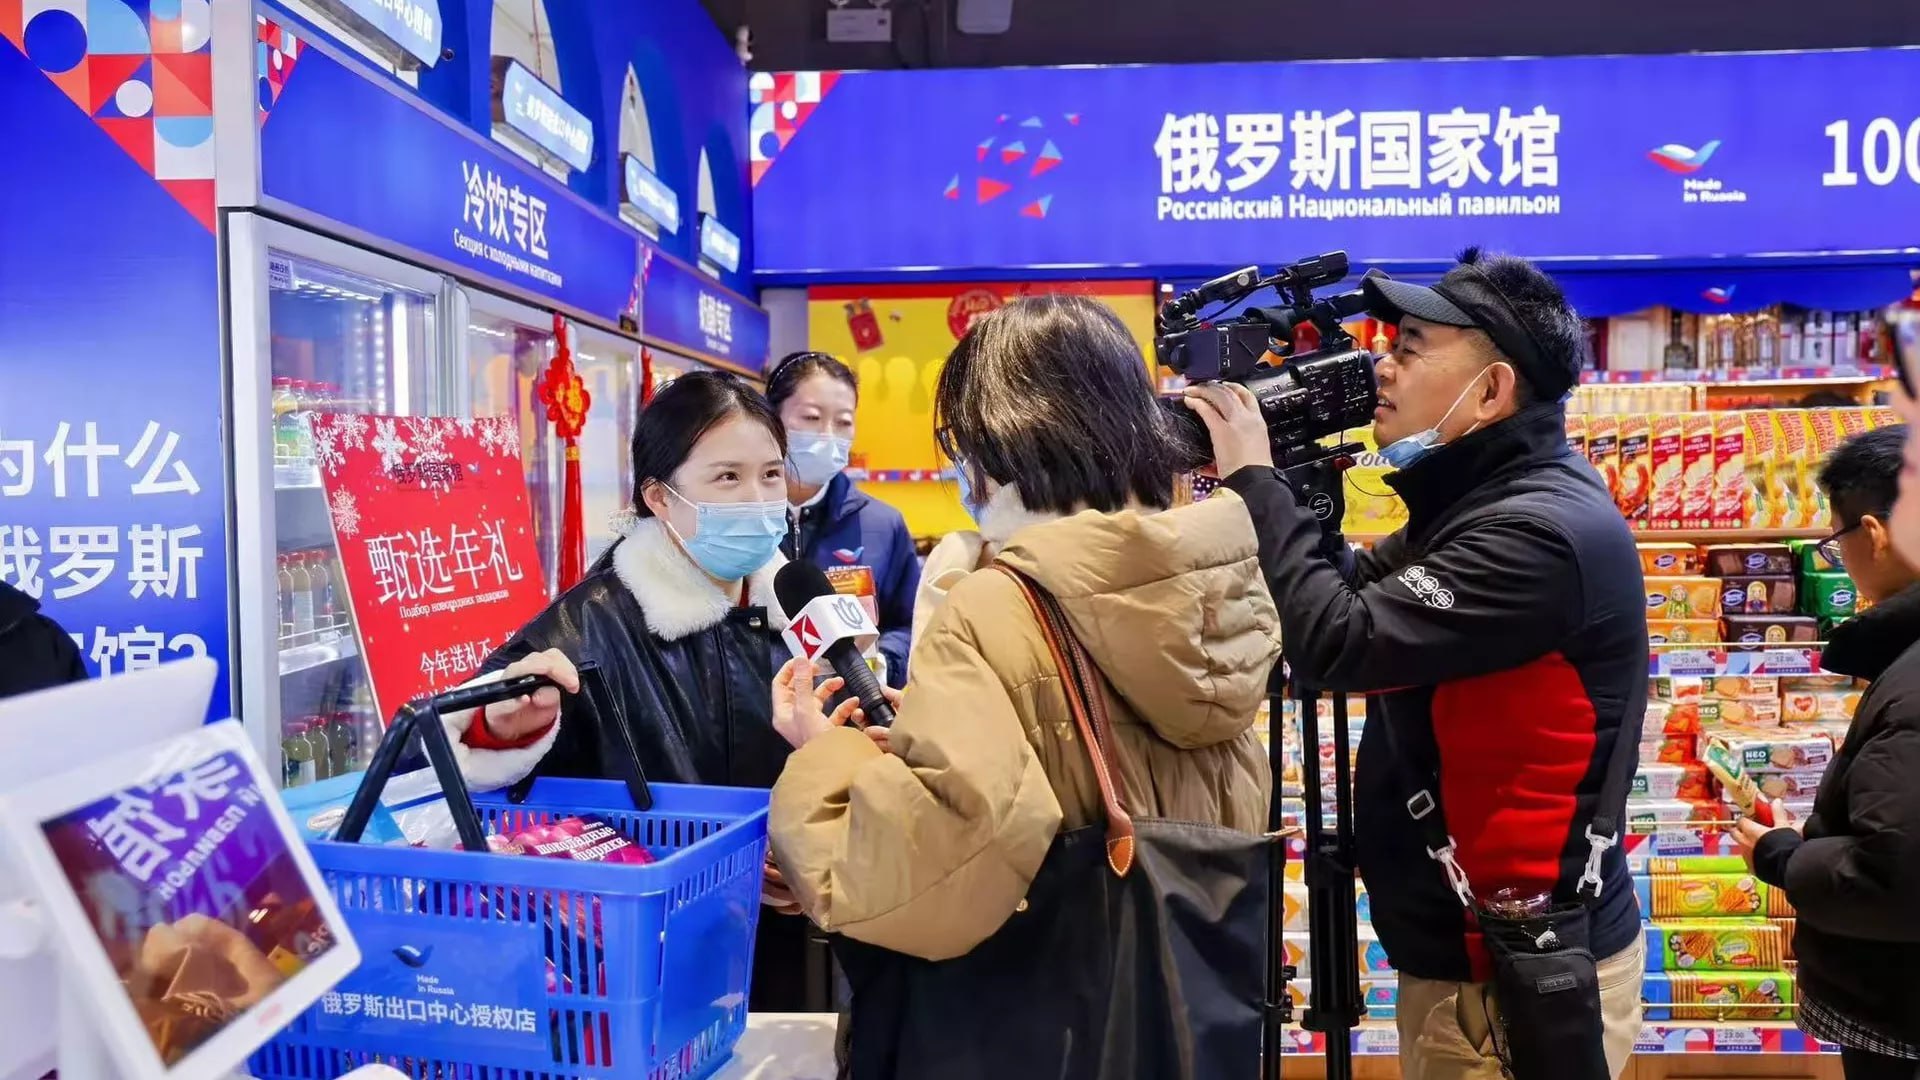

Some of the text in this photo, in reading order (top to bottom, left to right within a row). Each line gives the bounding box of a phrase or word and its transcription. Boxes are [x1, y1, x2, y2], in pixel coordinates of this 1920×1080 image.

[1154, 105, 1561, 193] 俄罗斯国家馆
[1683, 178, 1722, 191] Made
[1683, 190, 1747, 203] in Russia
[462, 159, 549, 261] 冷饮专区
[1157, 192, 1561, 221] Российский Национальный павильон
[453, 227, 484, 258] Секция
[364, 519, 525, 605] 甄选年礼
[1745, 750, 1767, 760] NEO
[536, 826, 616, 855] шоколадные
[416, 974, 440, 985] Made
[427, 985, 455, 996] Russia
[321, 991, 537, 1033] 俄罗斯出口中心授权店
